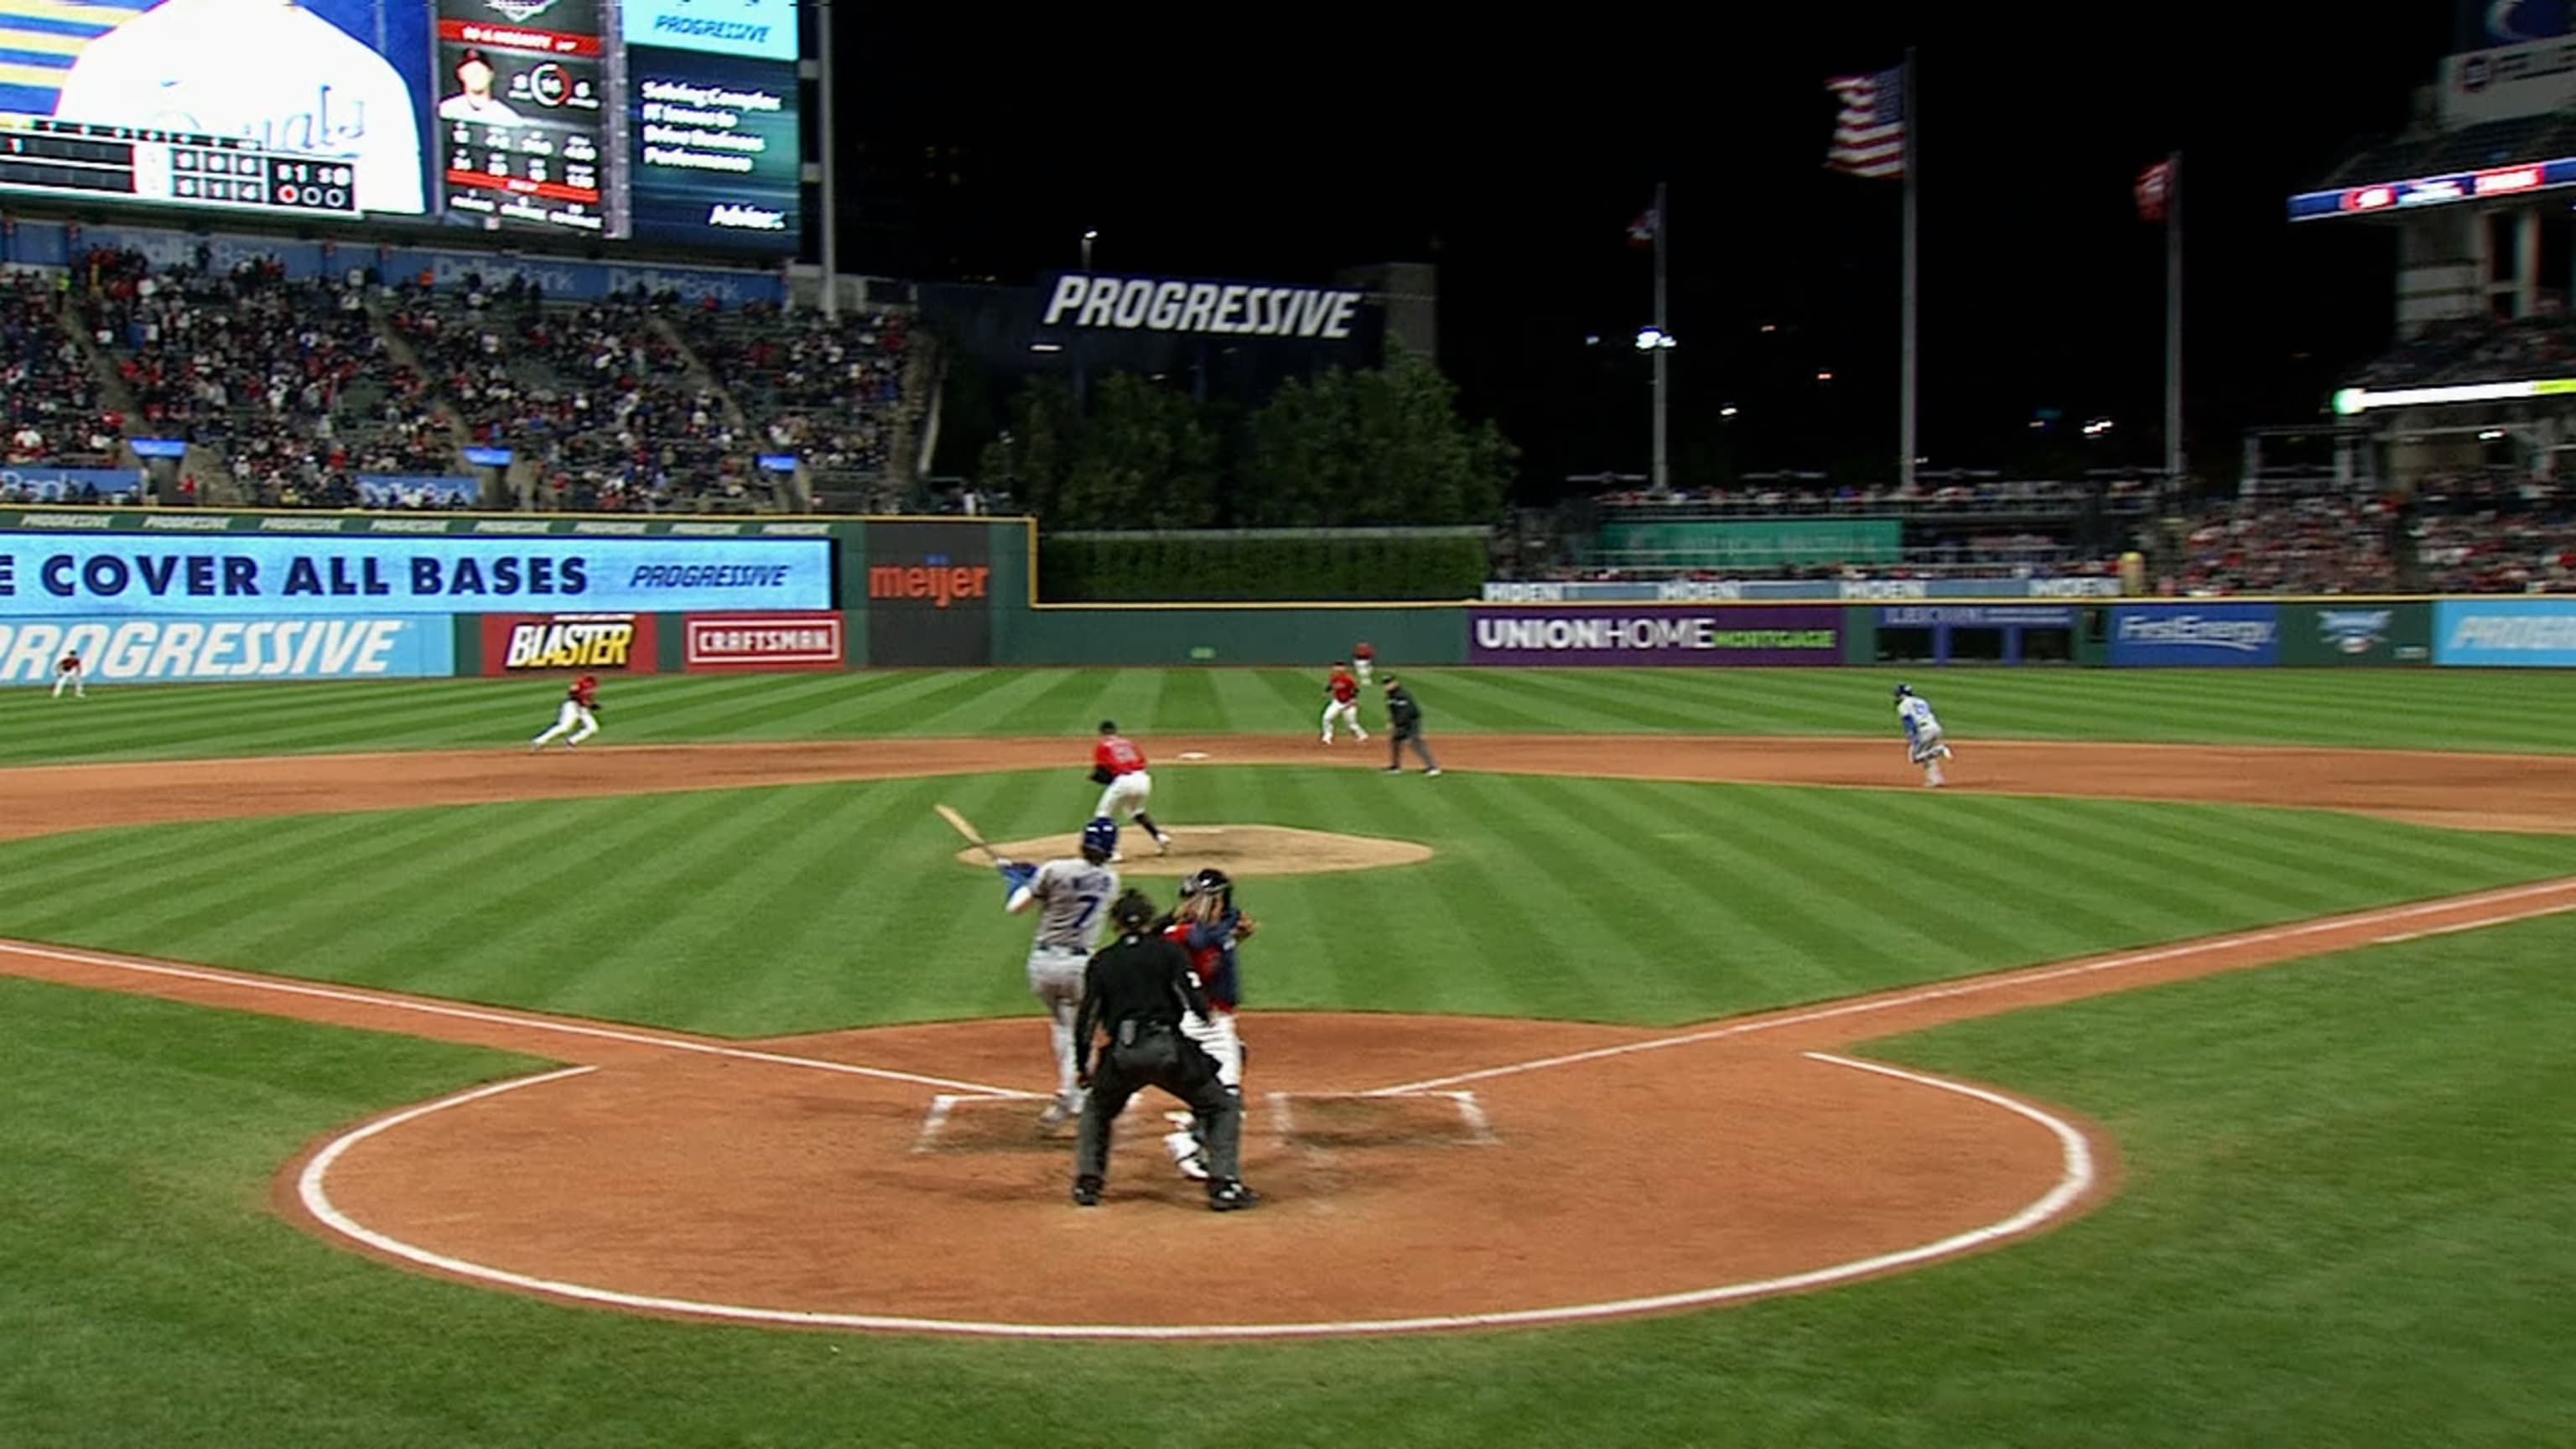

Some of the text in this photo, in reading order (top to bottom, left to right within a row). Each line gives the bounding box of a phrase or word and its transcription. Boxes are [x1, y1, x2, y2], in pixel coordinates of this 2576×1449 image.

[1043, 274, 1361, 338] PROGRESSIVE
[41, 555, 261, 596] COVER
[283, 556, 389, 596] ALL
[411, 557, 588, 596] BASES
[630, 564, 792, 588] PROGRESSIVE
[869, 553, 989, 607] meijer
[0, 620, 402, 682] ROGRESSIVE
[506, 623, 633, 667] BLASTER
[699, 630, 830, 652] CRAFTSMAN
[1073, 895, 1100, 929] 7
